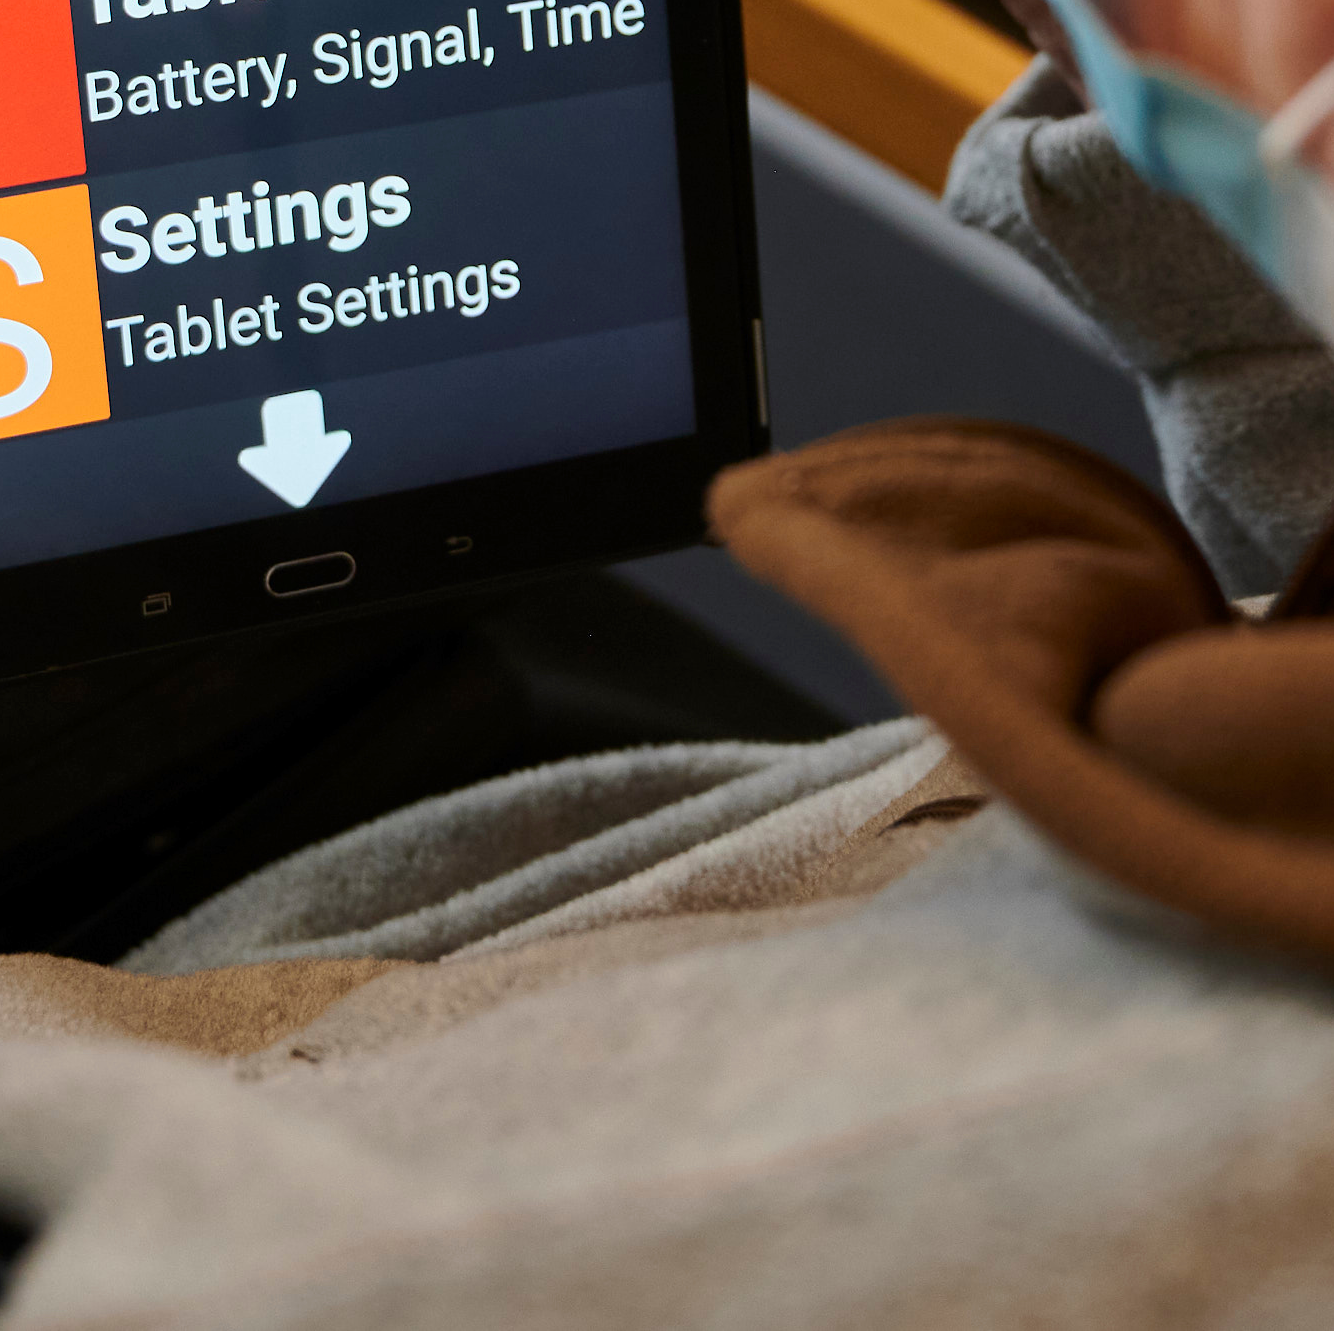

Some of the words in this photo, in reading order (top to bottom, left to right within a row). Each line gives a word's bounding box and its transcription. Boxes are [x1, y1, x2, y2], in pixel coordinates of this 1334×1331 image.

[84, 52, 298, 124] Battery,
[312, 7, 495, 89] Signal,
[98, 174, 411, 273] Settings
[105, 294, 284, 368] Tablet
[297, 258, 522, 334] Settings
